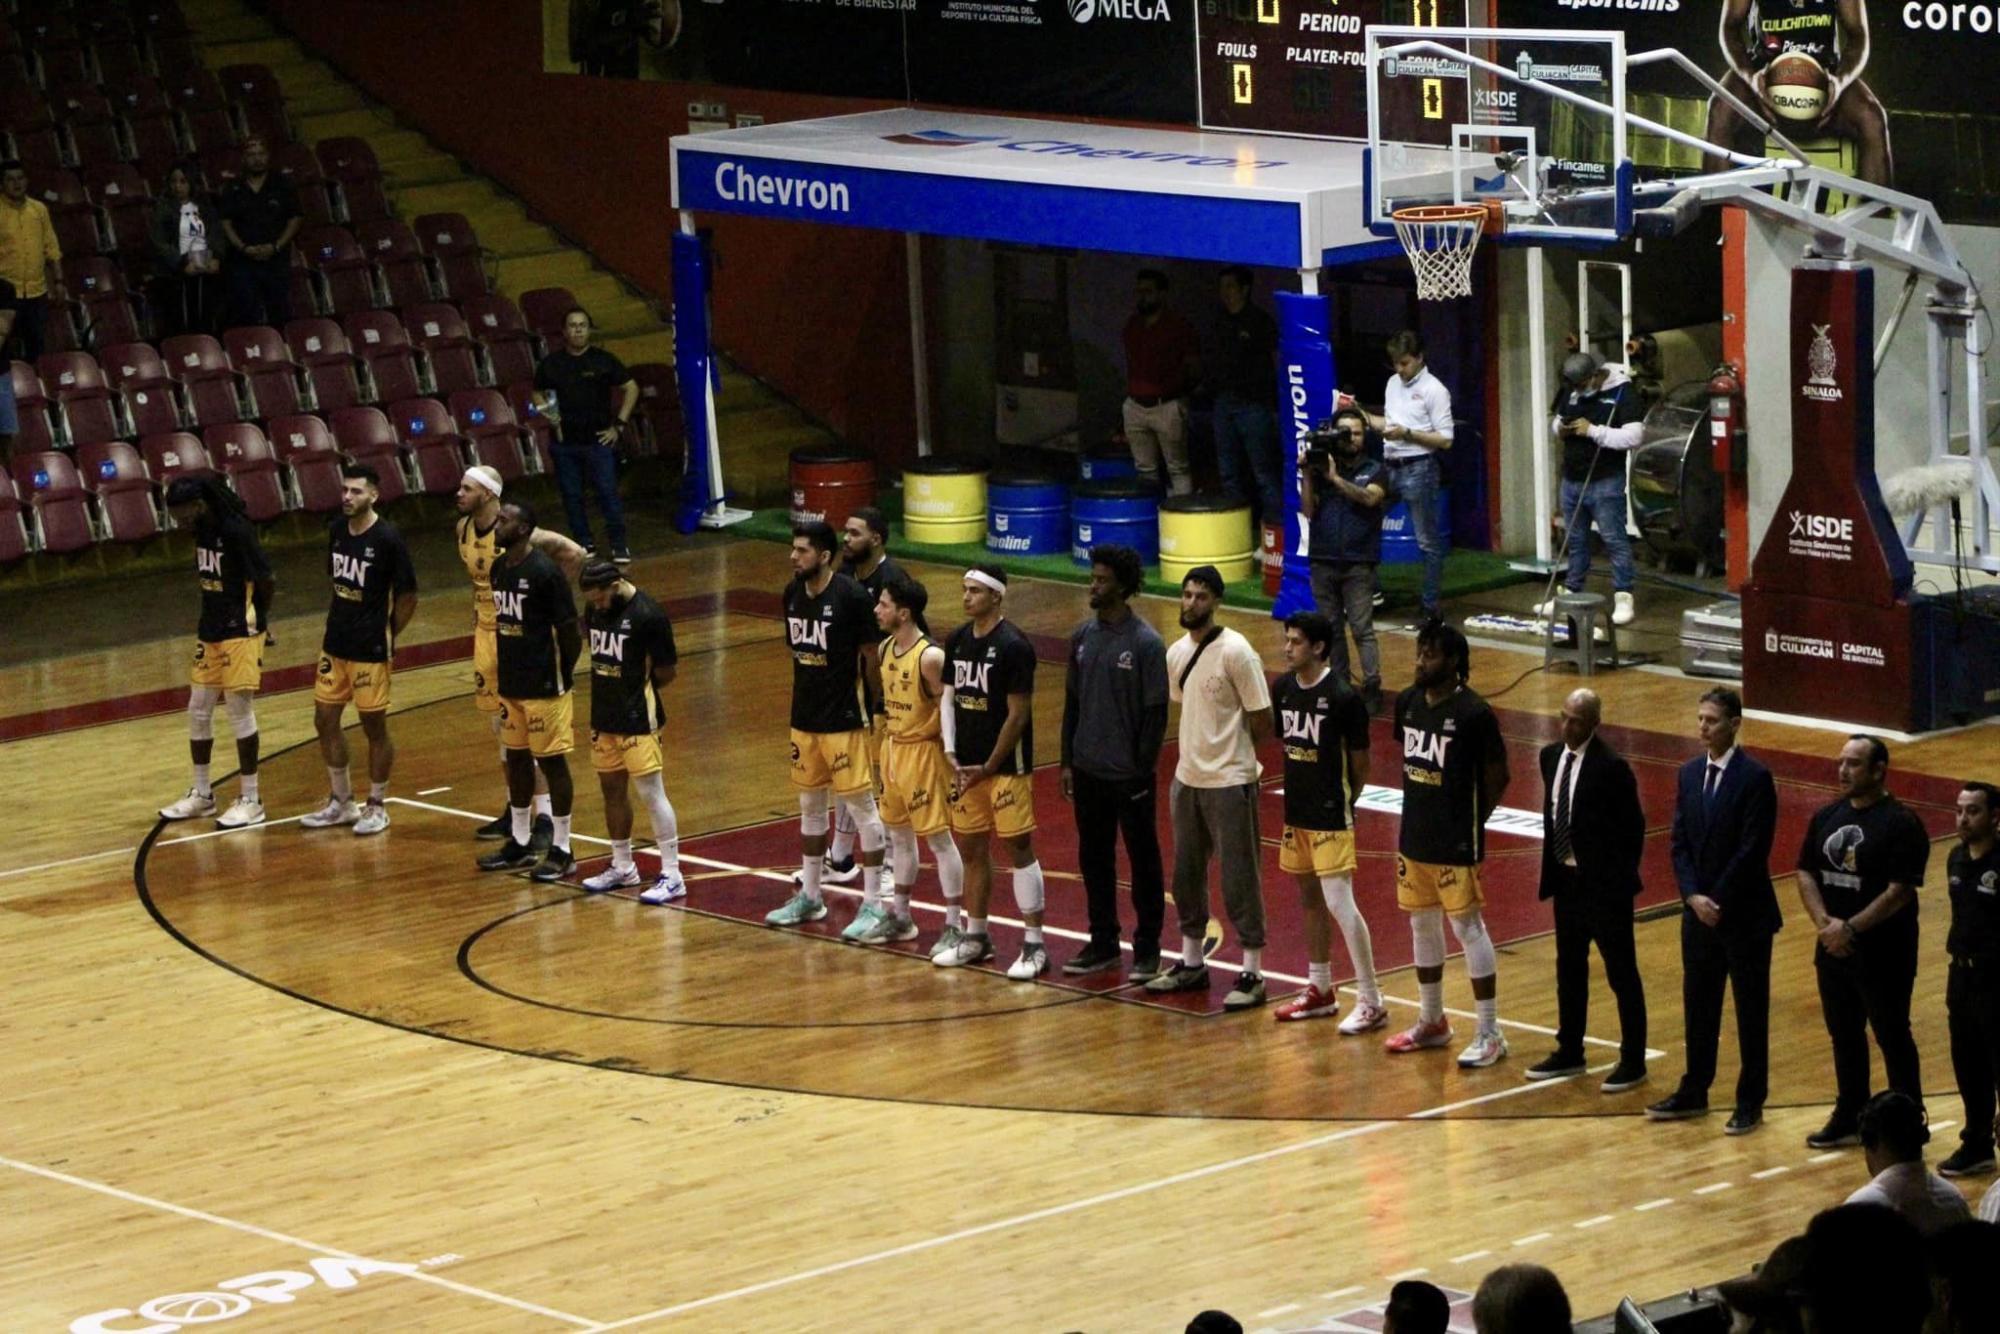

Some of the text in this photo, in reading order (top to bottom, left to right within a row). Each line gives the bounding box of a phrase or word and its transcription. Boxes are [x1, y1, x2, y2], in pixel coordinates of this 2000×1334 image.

[854, 0, 917, 10] BIENESTAR
[948, 2, 1034, 15] INSTITUTO MUNICIPAL DEL
[1098, 0, 1171, 22] MEGA
[941, 10, 971, 20] DEPORTE
[979, 13, 987, 21] LA
[989, 14, 1018, 23] CULTURA
[1299, 13, 1361, 34] PERIOD
[1761, 14, 1832, 32] CULICHITOWN
[1902, 0, 2000, 34] coro
[1217, 42, 1258, 59] FOULS
[1485, 91, 1518, 107] ISDE
[998, 140, 1289, 169] Chevron
[1558, 157, 1606, 174] Fincamex
[715, 161, 850, 212] Chevron
[1802, 385, 1843, 399] SINALOA
[1806, 514, 1853, 541] ISDE
[1842, 643, 1884, 658] CAPITAL
